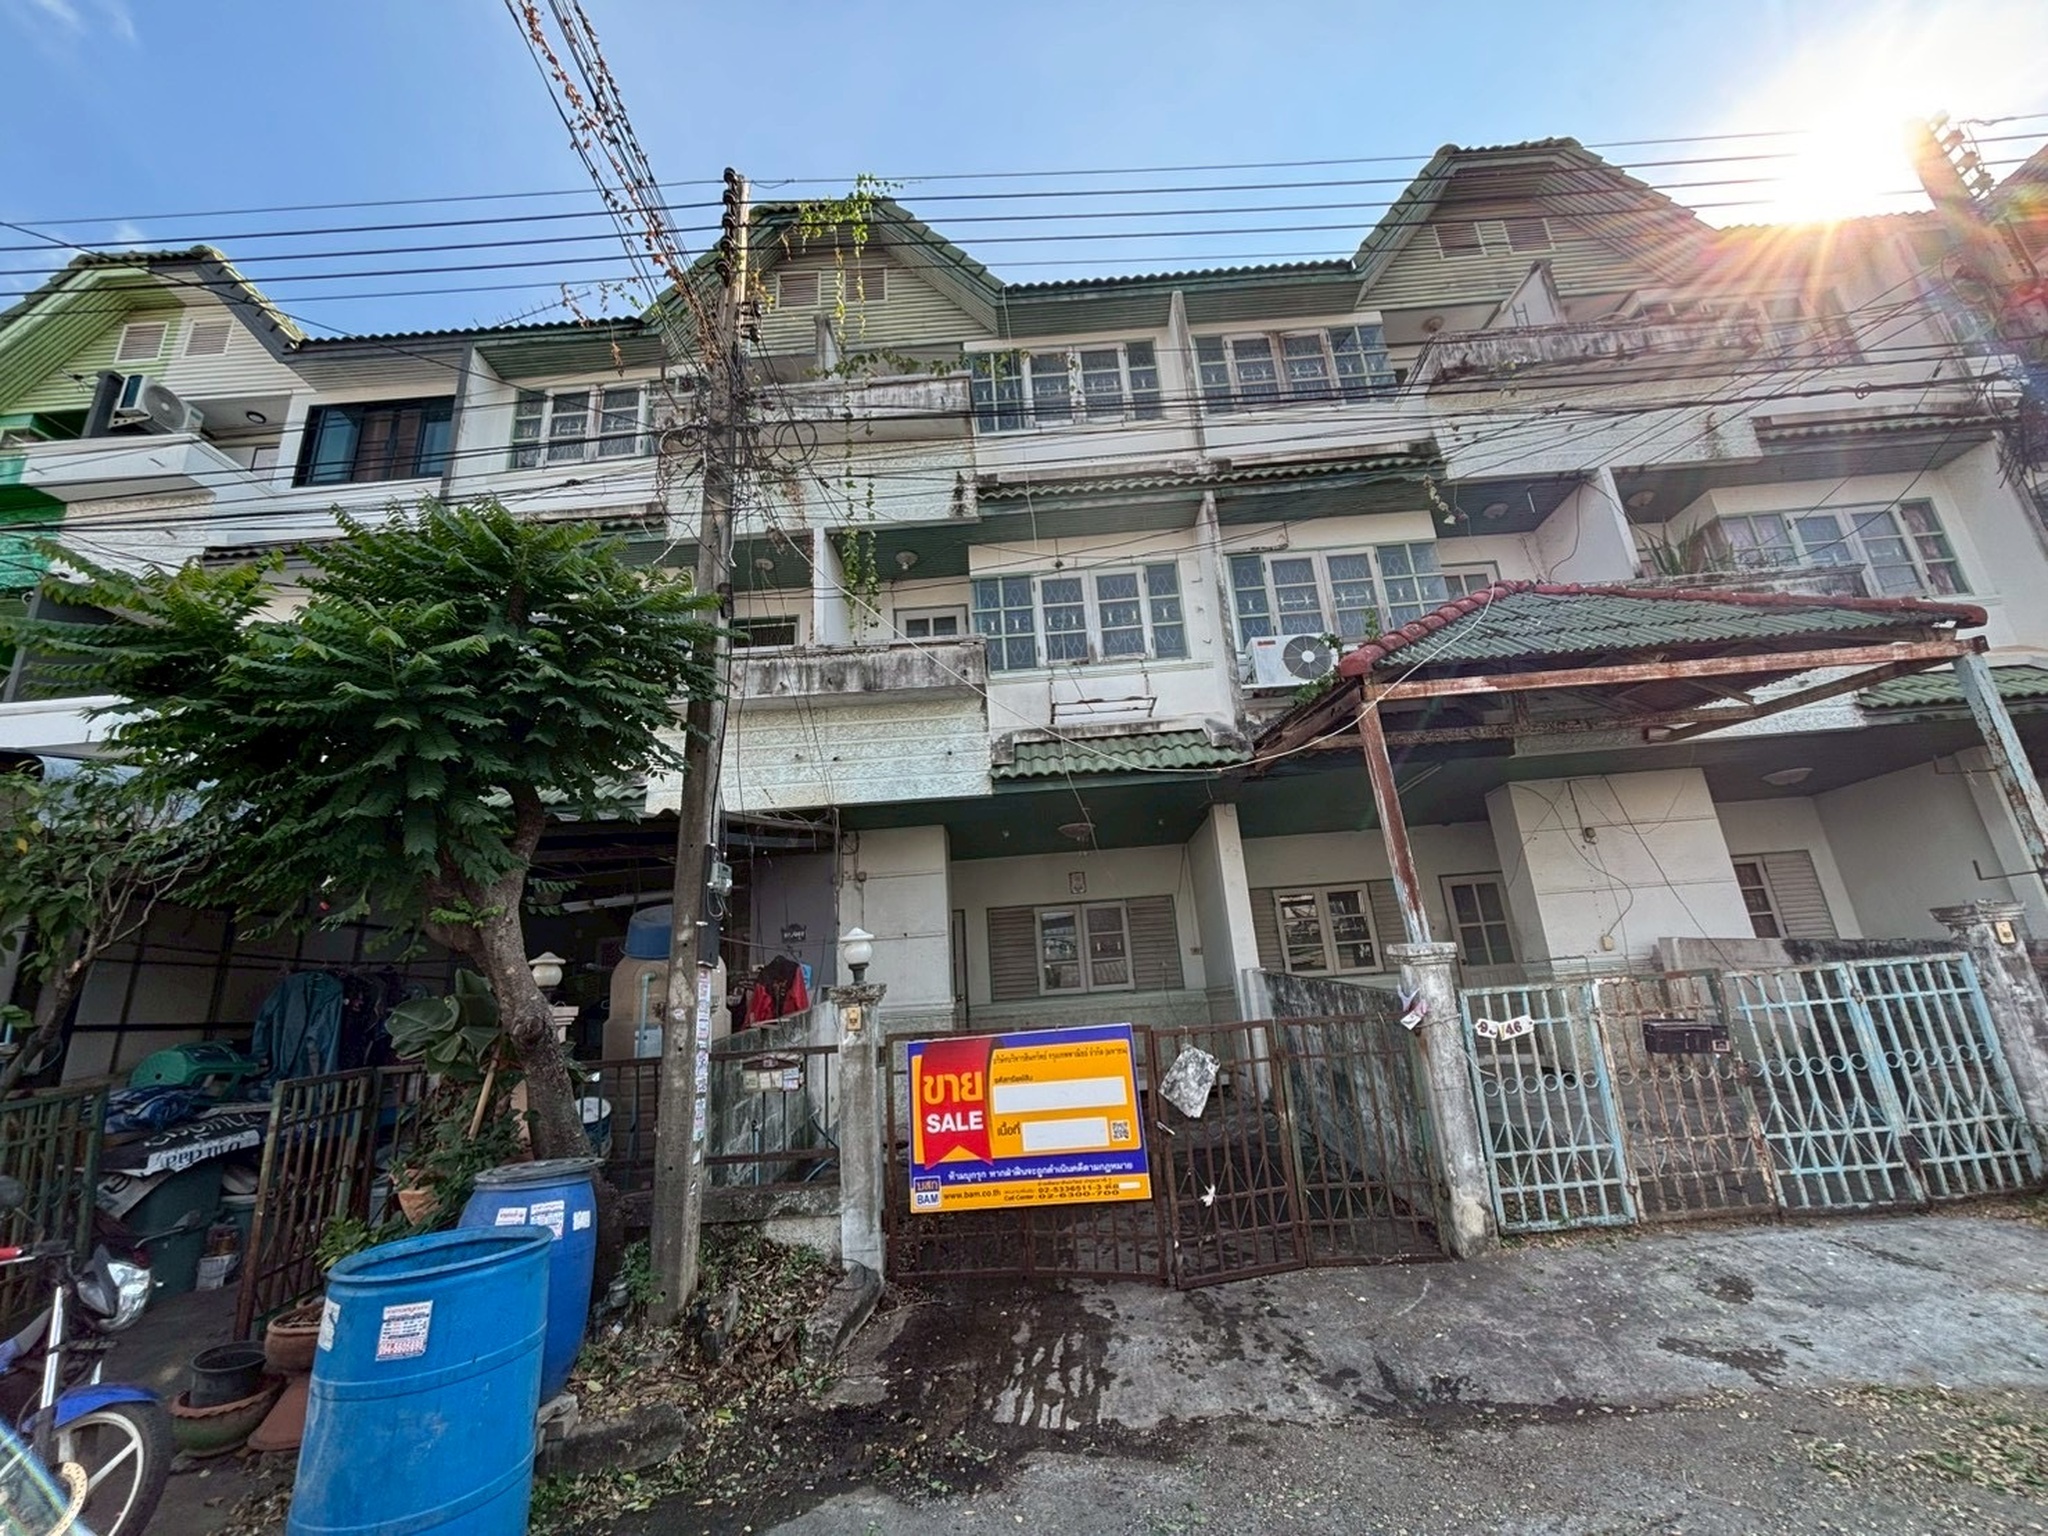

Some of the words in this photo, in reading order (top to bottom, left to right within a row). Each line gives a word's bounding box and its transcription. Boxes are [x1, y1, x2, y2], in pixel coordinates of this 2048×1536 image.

[923, 1071, 984, 1105] ขาย
[926, 1110, 984, 1134] SALE
[917, 1193, 939, 1205] BAM
[944, 1189, 1001, 1200] www.bam.co.th
